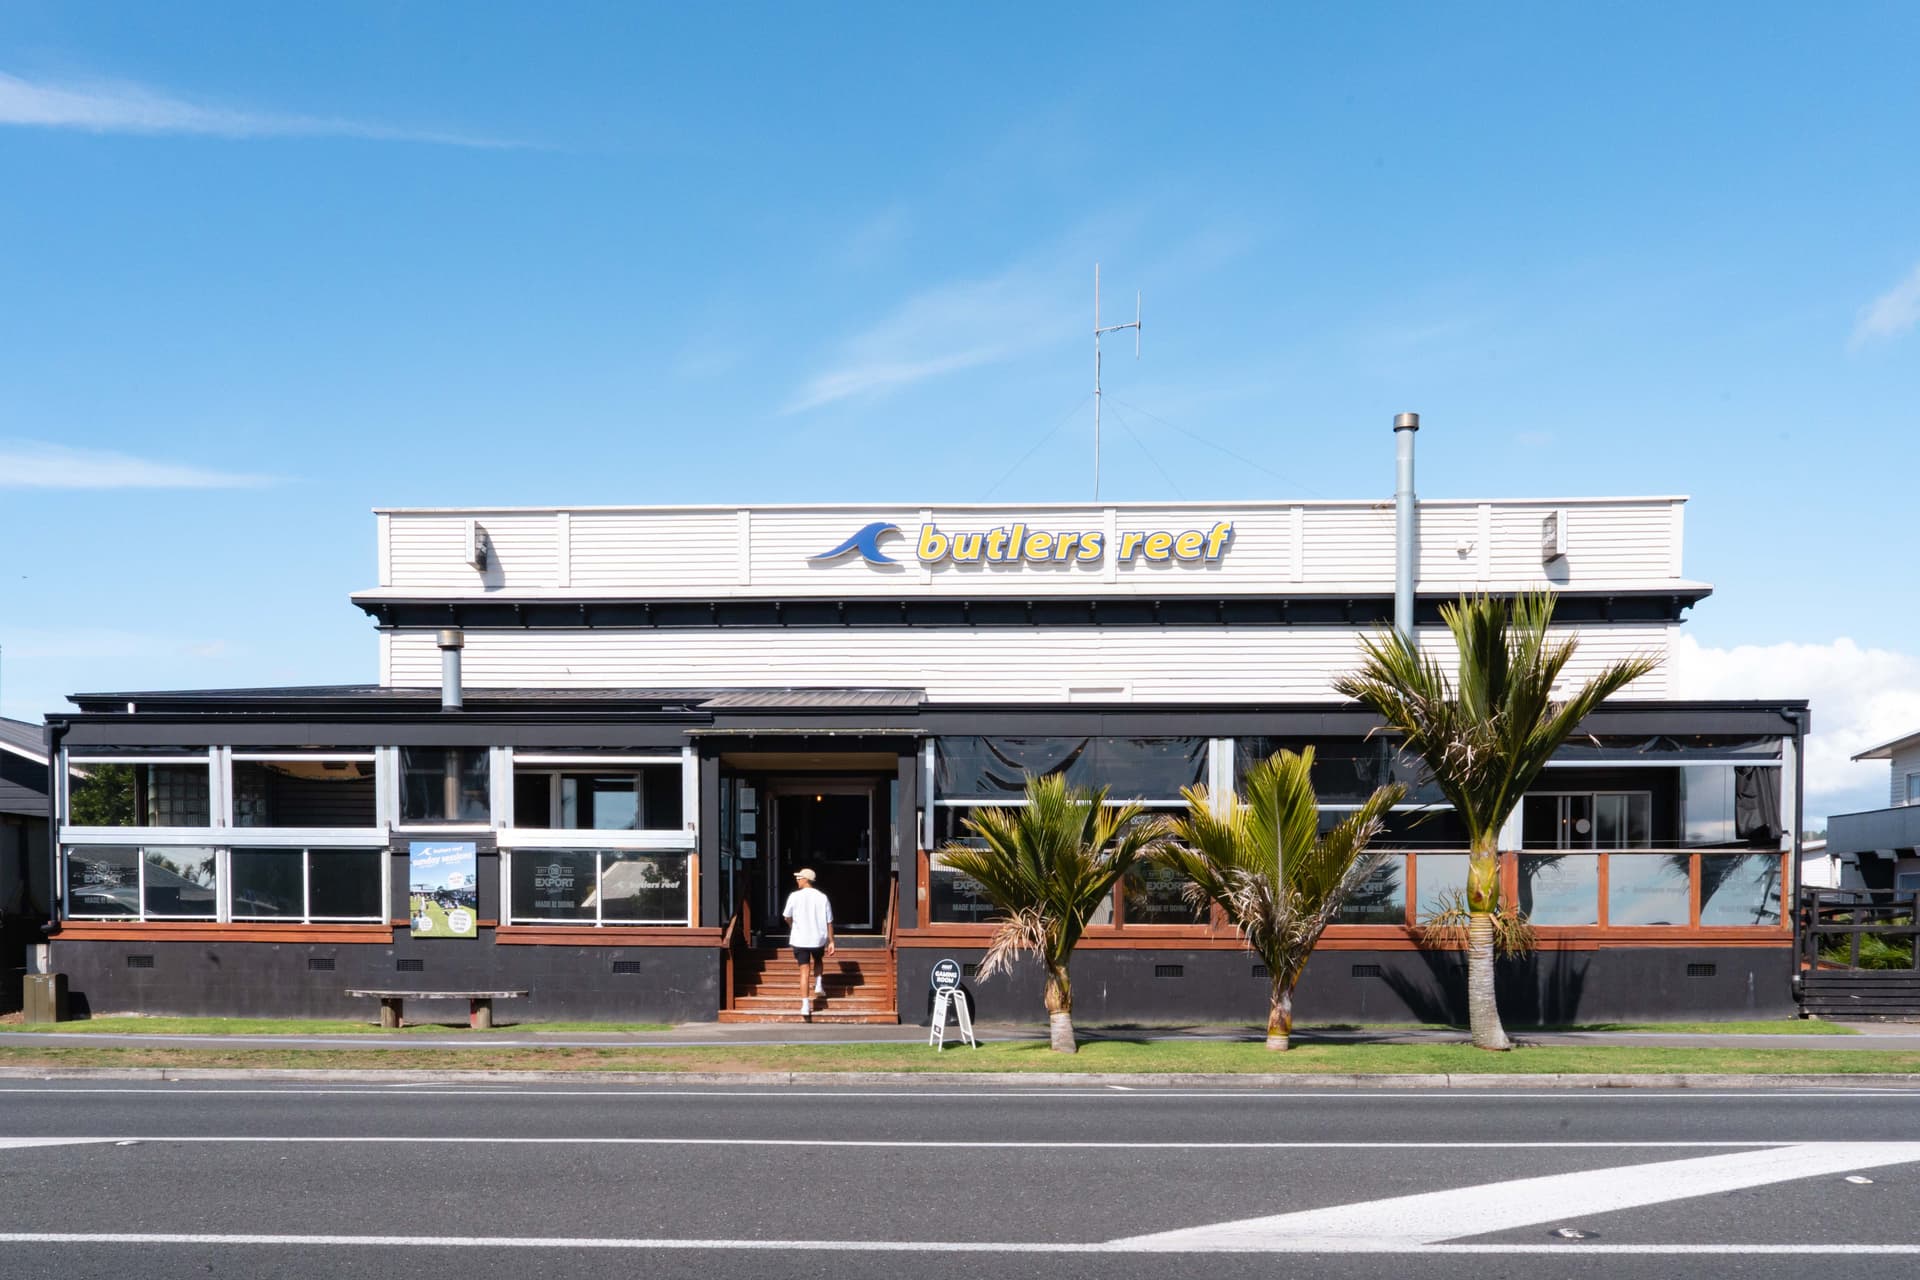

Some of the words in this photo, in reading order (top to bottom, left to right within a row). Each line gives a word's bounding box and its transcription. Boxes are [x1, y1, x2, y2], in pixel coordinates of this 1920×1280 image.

[916, 523, 1103, 562] butlers
[1118, 521, 1234, 562] reef
[535, 878, 575, 887] EXPORT
[952, 880, 988, 890] EXPOR
[935, 970, 957, 979] GAMING
[936, 976, 954, 984] ROOM
